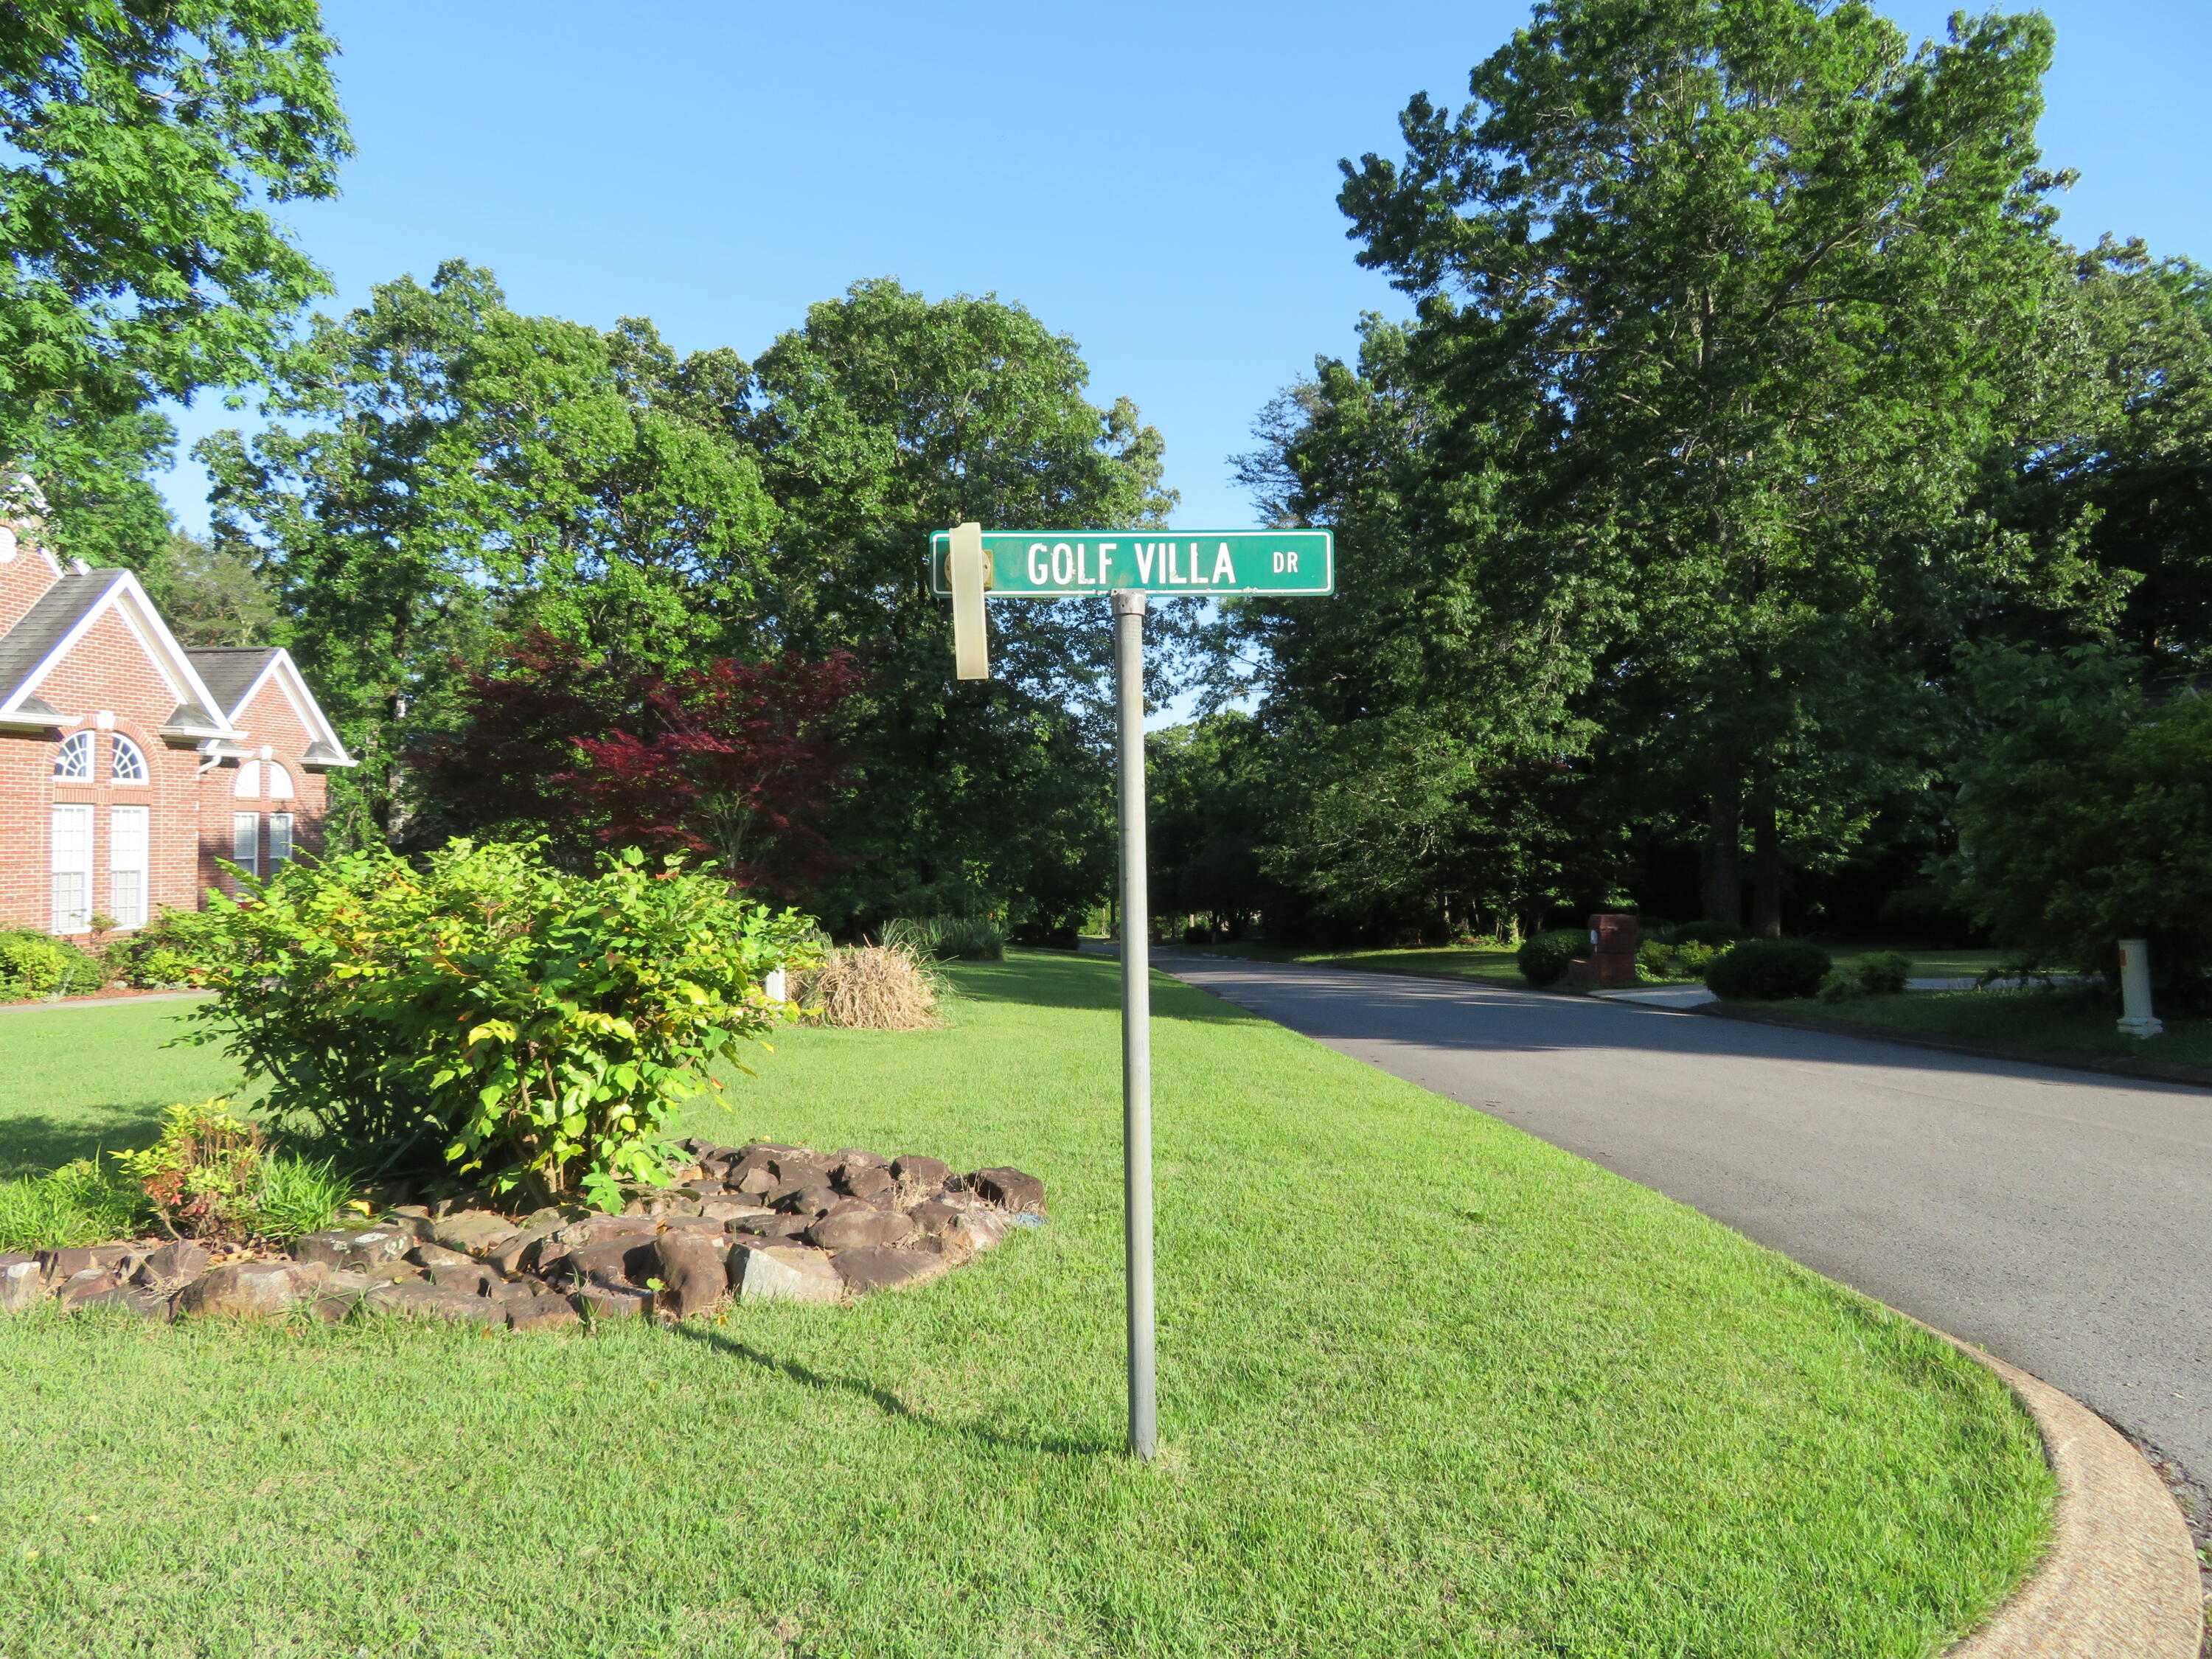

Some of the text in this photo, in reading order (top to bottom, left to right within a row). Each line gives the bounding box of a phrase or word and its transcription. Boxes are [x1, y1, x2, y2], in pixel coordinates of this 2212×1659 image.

[1028, 542, 1299, 585] GOLF VILLA DR
